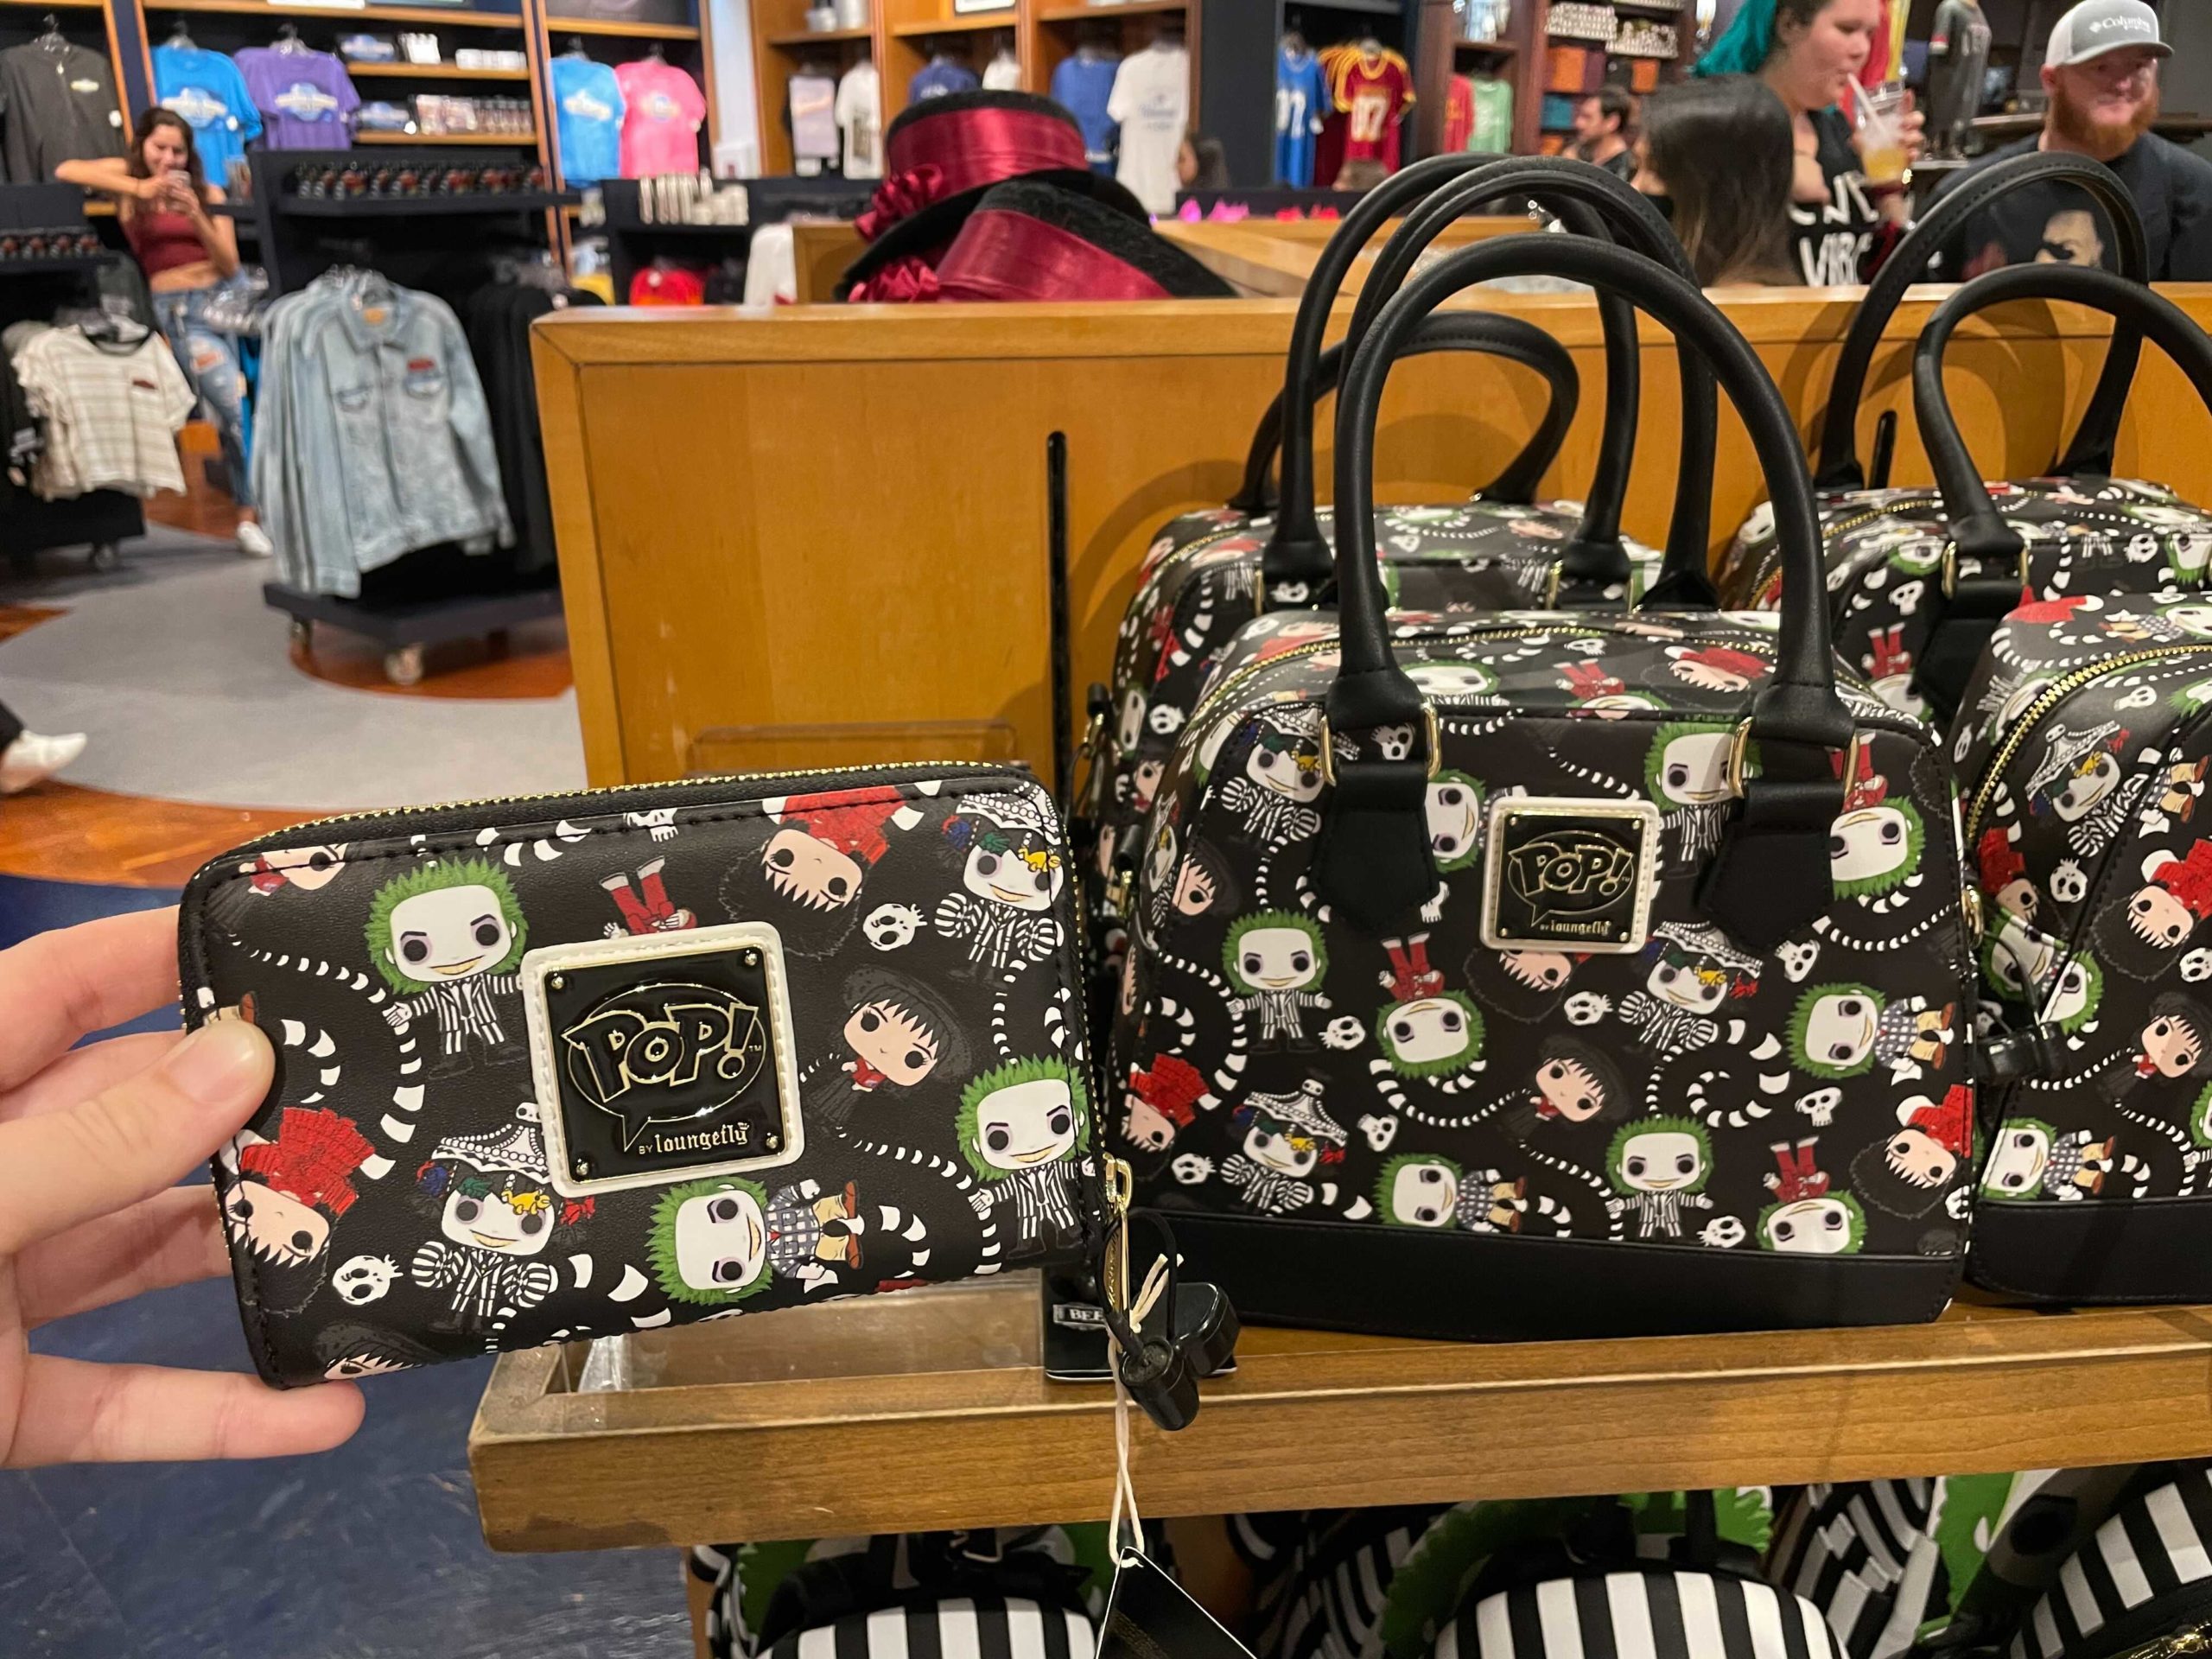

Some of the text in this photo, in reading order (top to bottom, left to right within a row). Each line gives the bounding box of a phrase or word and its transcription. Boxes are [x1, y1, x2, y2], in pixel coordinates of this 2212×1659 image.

[1508, 842, 1634, 897] POP!
[561, 1002, 760, 1103] POP!
[639, 1122, 750, 1154] BY loungefly
